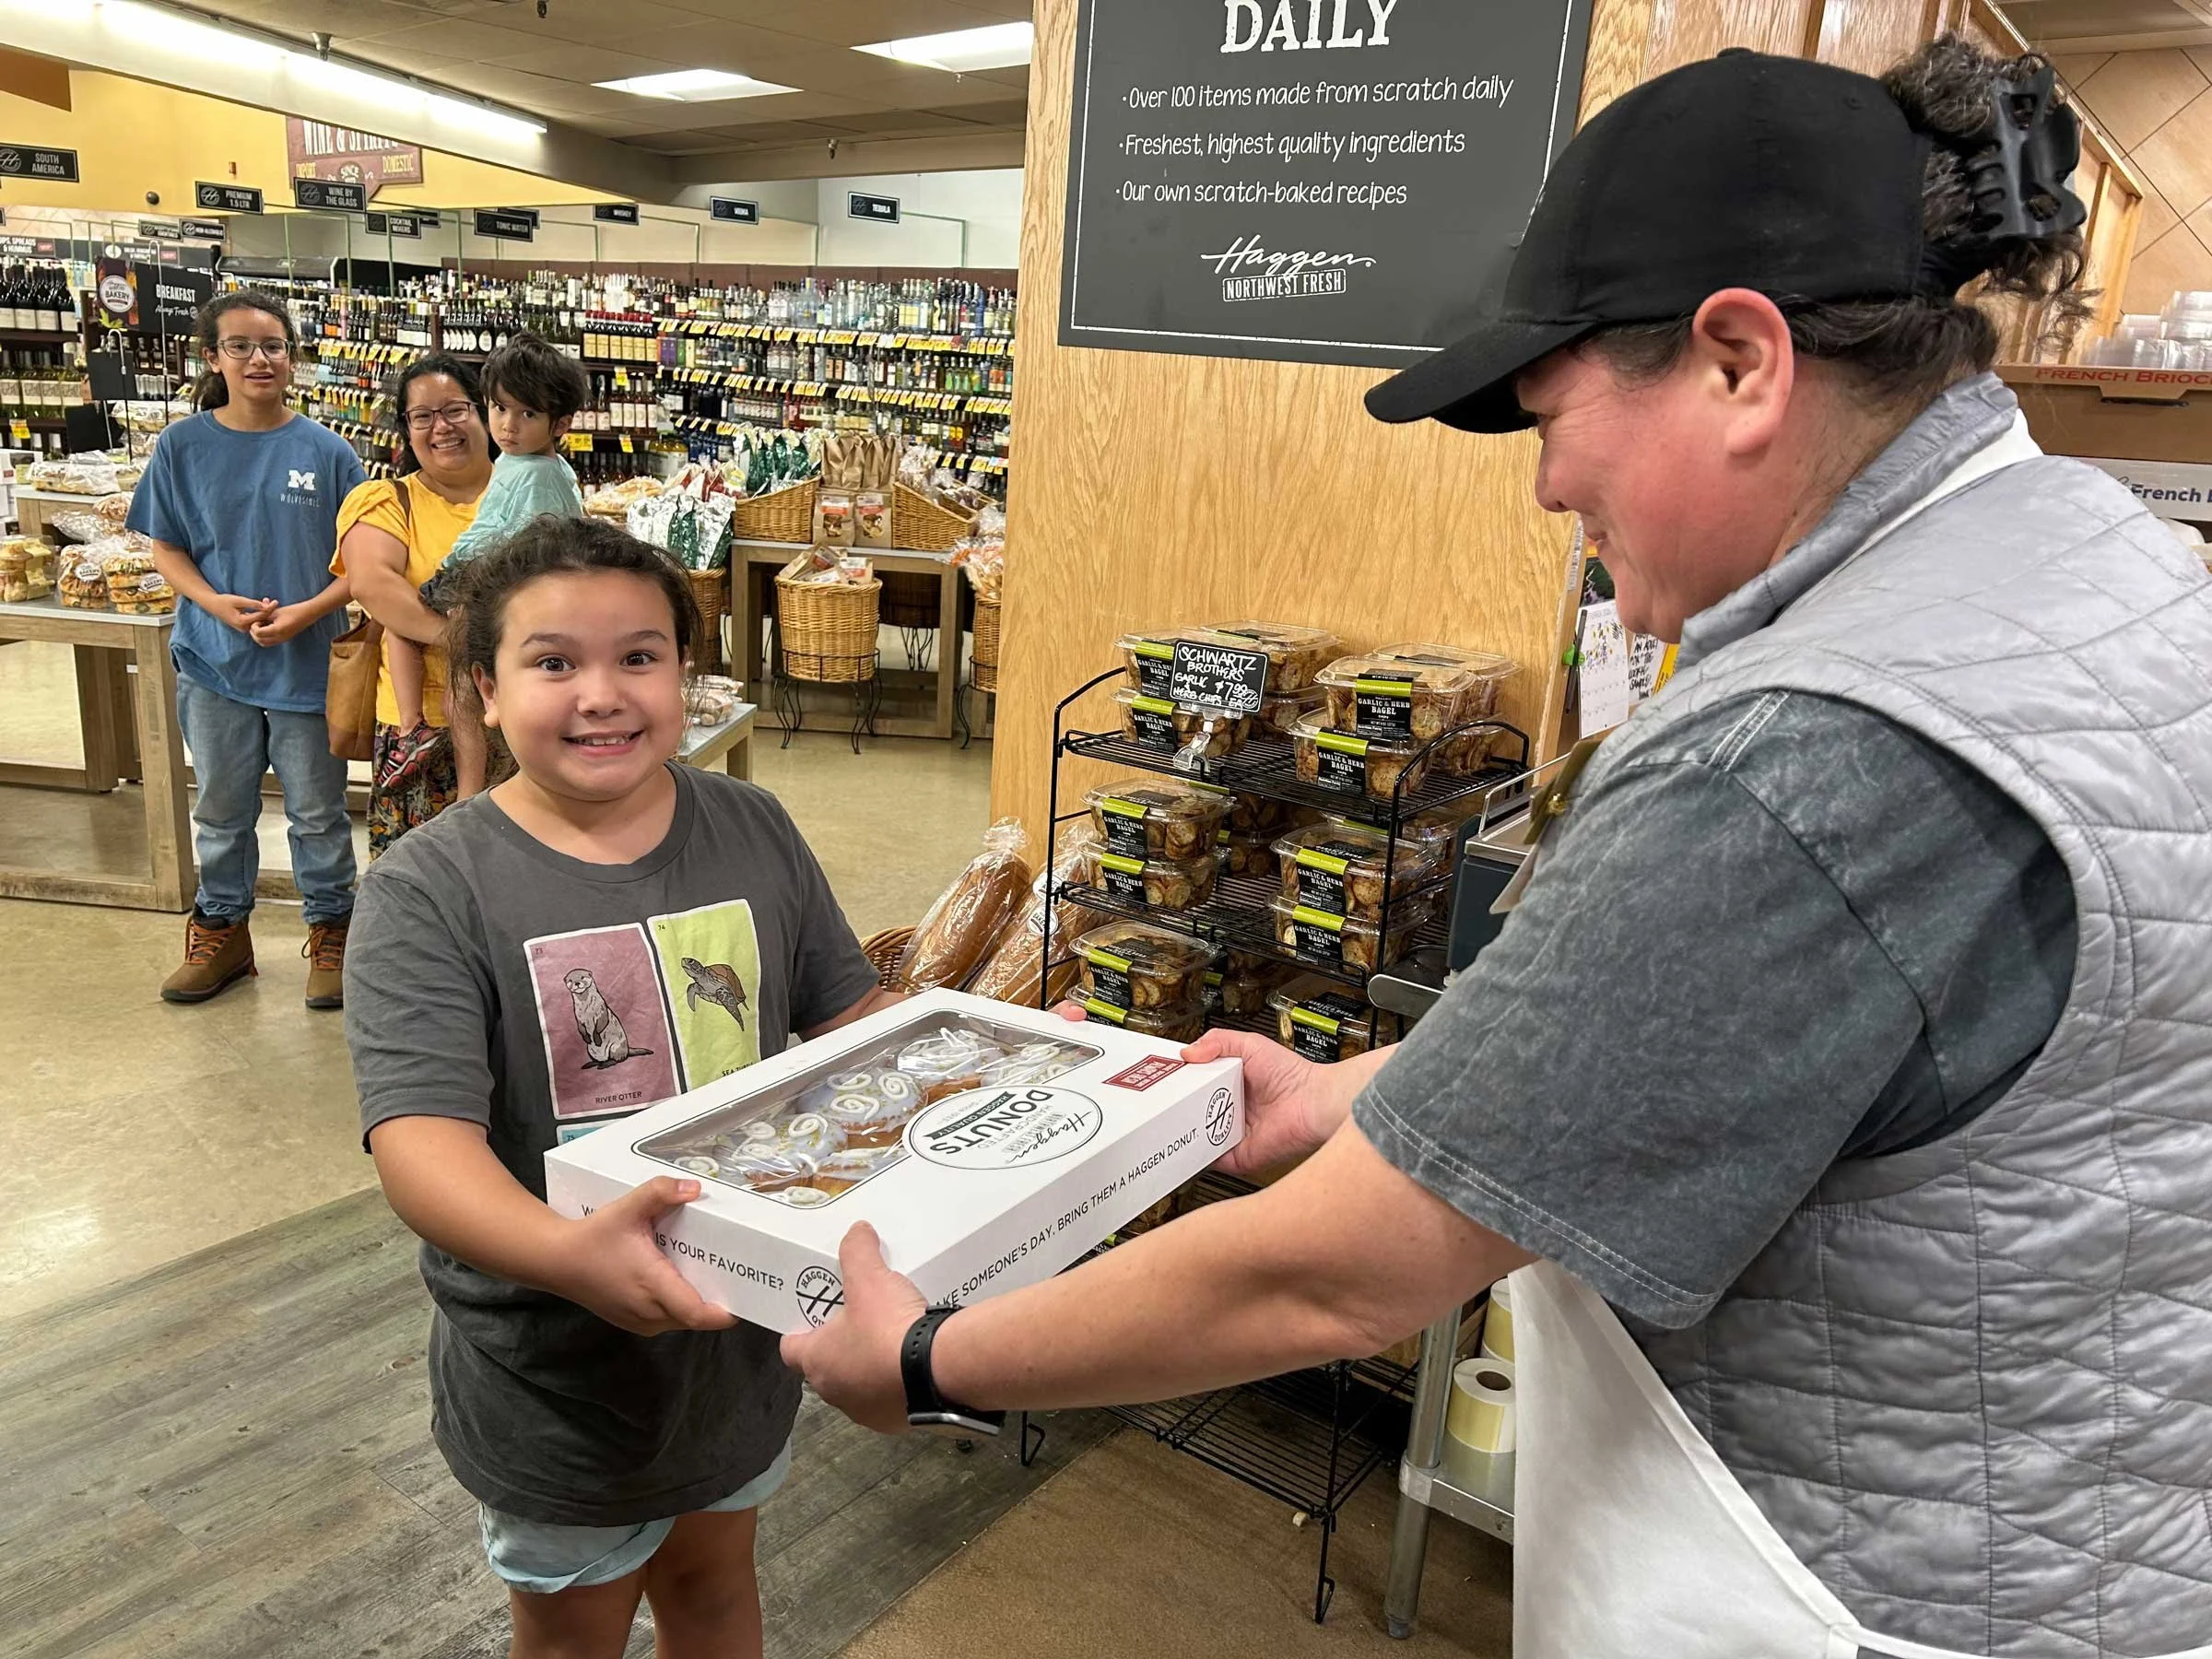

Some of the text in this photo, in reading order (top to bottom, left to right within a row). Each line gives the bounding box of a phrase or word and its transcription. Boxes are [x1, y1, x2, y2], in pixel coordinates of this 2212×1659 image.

[1220, 0, 1397, 53] DAILY
[1171, 86, 1195, 108] 100
[1198, 84, 1252, 107] items
[1255, 81, 1311, 105] made
[1315, 80, 1368, 104] from
[1372, 76, 1457, 102] scratch
[1462, 74, 1514, 108] daily
[1125, 129, 1465, 163] Freshest, highest quality ingredients
[35, 153, 59, 163] SOUTH
[31, 163, 65, 175] AMERICA
[226, 190, 253, 200] PREMIUM
[328, 187, 353, 196] WINE BY
[1122, 181, 1408, 210] Our own scratch-baked recipes
[325, 196, 358, 207] THE GLASS
[1201, 234, 1377, 276] Haggen
[156, 284, 195, 302] BREAKFAST
[1226, 271, 1343, 300] NORTHWEST FRESH
[2036, 369, 2212, 384] FRENCH BRIOC
[288, 470, 316, 490] M
[2131, 484, 2201, 502] French
[1179, 646, 1257, 671] SCHWARTZ
[1150, 667, 1169, 677] BAGEL
[1175, 672, 1208, 688] GARLIC
[1187, 662, 1244, 682] BROTHERS
[1173, 687, 1197, 700] HERB
[1198, 693, 1222, 706] CHIPS
[1358, 698, 1382, 707] GARLIC
[1391, 700, 1410, 709] HERB
[1371, 706, 1396, 715] BAGEL
[1146, 722, 1165, 732] BAGEL
[1319, 752, 1341, 762] GARLIC
[1347, 759, 1364, 769] HERB
[1331, 761, 1353, 772] BAGEL
[1116, 824, 1135, 833] BAGEL
[1115, 881, 1133, 891] BAGEL
[1298, 869, 1320, 879] GARLIC
[1327, 877, 1343, 887] HERB
[1312, 878, 1333, 888] BAGEL
[1295, 925, 1317, 935] GARLIC
[1324, 933, 1340, 943] HERB
[1308, 934, 1330, 946] BAGEL
[1306, 1034, 1327, 1047] BAGEL
[722, 1068, 735, 1077] SEA
[595, 1090, 641, 1104] RIVER OTTER
[979, 1095, 1008, 1114] HAGGEN
[930, 1089, 1053, 1154] DONUTS
[937, 1115, 977, 1136] QUALITY
[961, 1242, 1028, 1296] SOMEONE'S
[1030, 1226, 1055, 1253] DAY.
[1057, 1201, 1088, 1230] BRING
[1091, 1183, 1117, 1208] THEM
[1119, 1176, 1126, 1187] A
[1128, 1150, 1166, 1183] HAGGEN
[655, 1232, 784, 1290] IS YOUR FAVORITE?
[801, 1271, 836, 1288] HAGGEN
